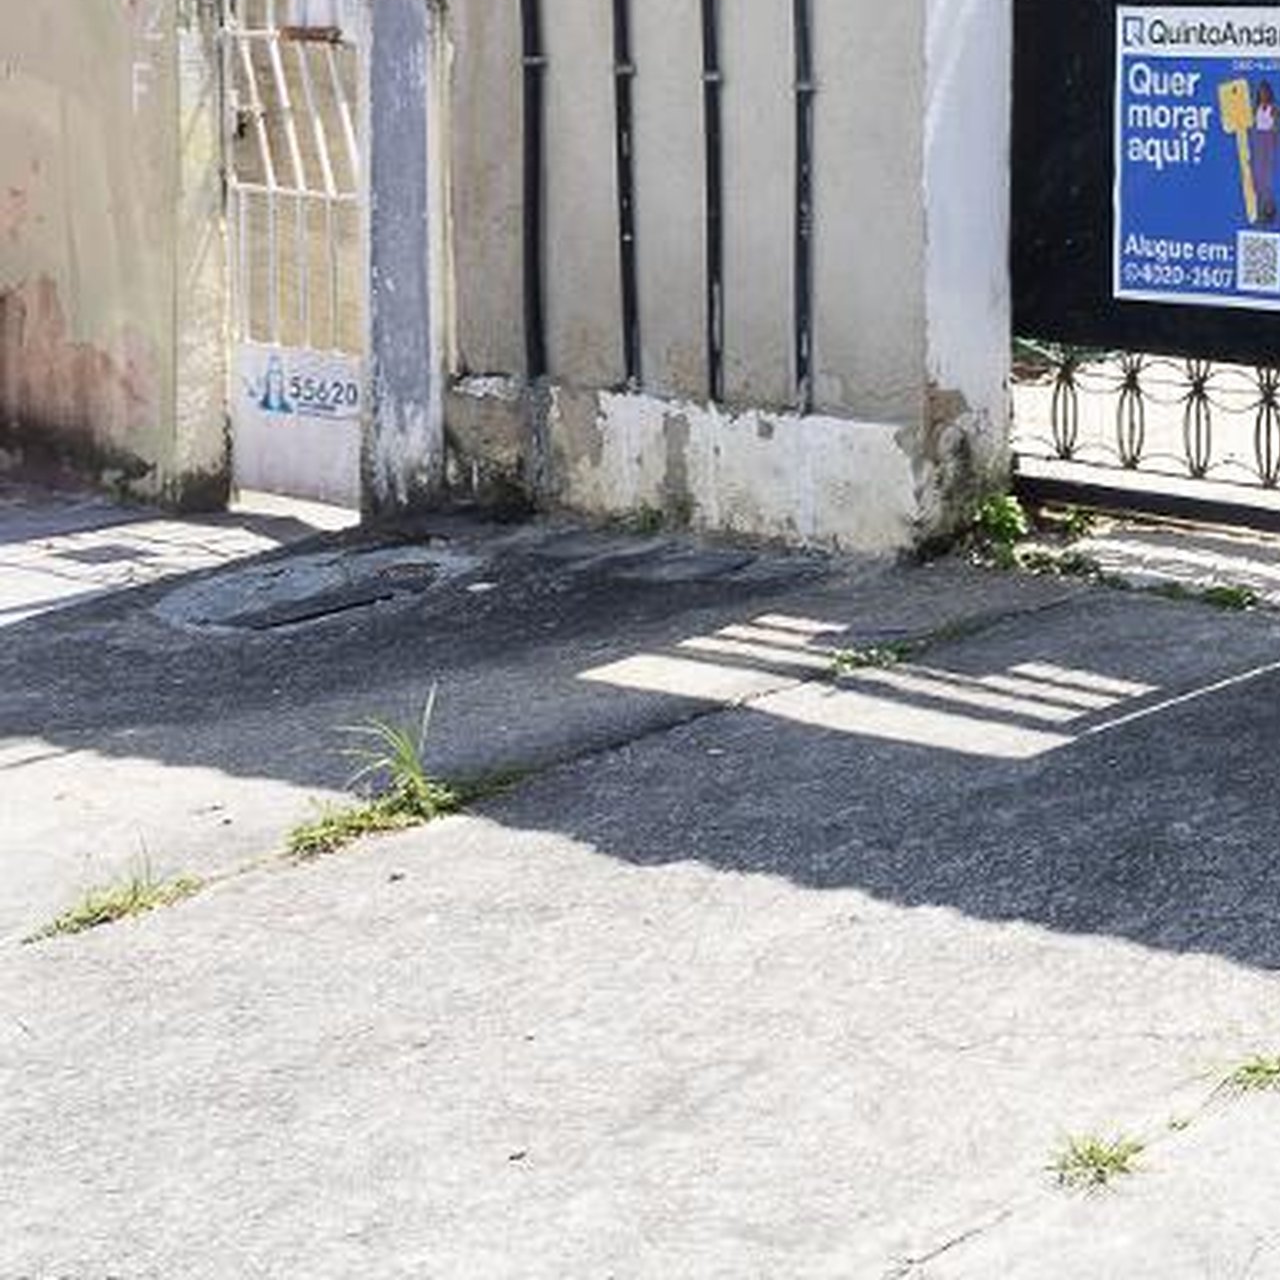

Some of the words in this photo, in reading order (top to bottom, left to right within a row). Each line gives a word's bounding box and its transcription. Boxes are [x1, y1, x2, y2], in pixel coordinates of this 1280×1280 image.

[1128, 62, 1200, 97] Quer
[1128, 104, 1212, 130] morar
[1128, 132, 1205, 171] aqui?
[1124, 234, 1195, 263] Alugue
[1197, 243, 1235, 262] em:
[289, 376, 359, 406] 55620
